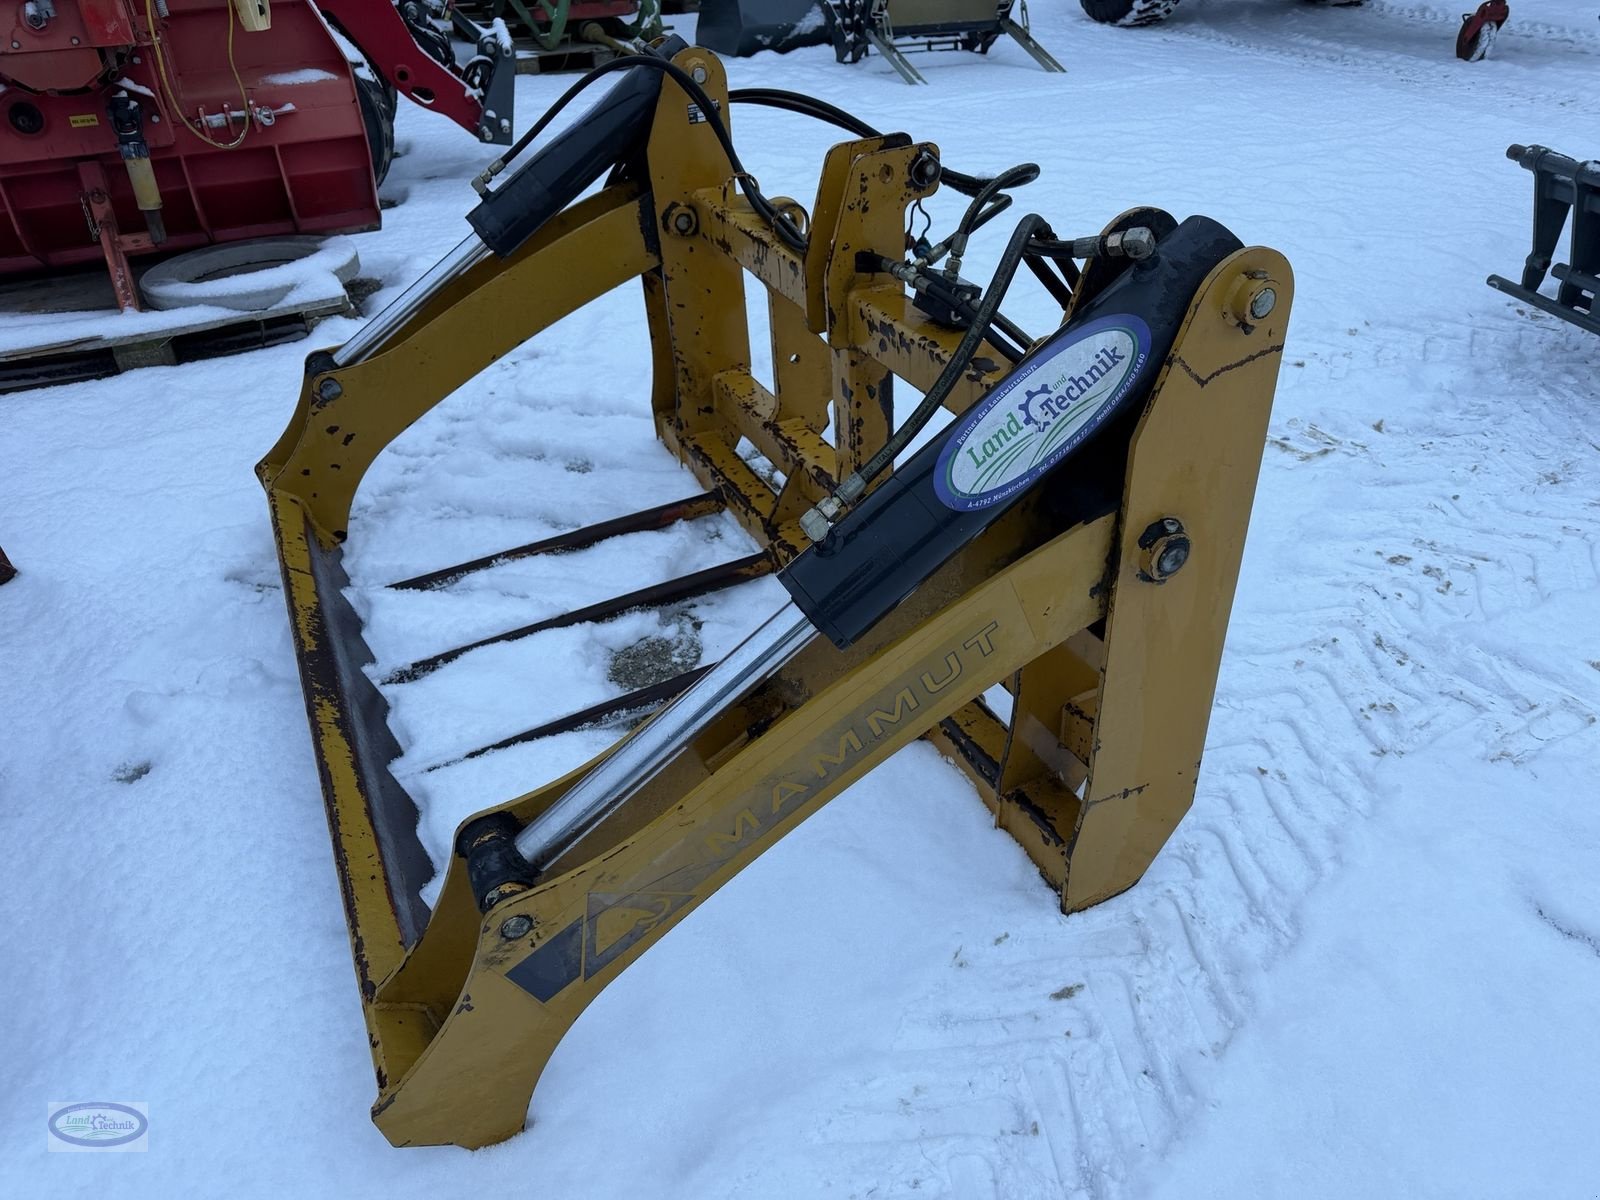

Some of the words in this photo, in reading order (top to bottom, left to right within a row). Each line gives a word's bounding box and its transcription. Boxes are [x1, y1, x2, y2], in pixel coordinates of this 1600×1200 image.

[956, 419, 979, 445] Partner
[978, 408, 989, 419] der
[989, 363, 1038, 409] Landwirtschaft
[1040, 344, 1126, 420] Technik
[1052, 375, 1068, 391] und
[966, 411, 1024, 469] Land
[967, 497, 991, 508] A-4792
[993, 477, 1030, 502] Münzkirchen
[1096, 404, 1112, 422] Mobil
[705, 621, 998, 856] MAMMUT
